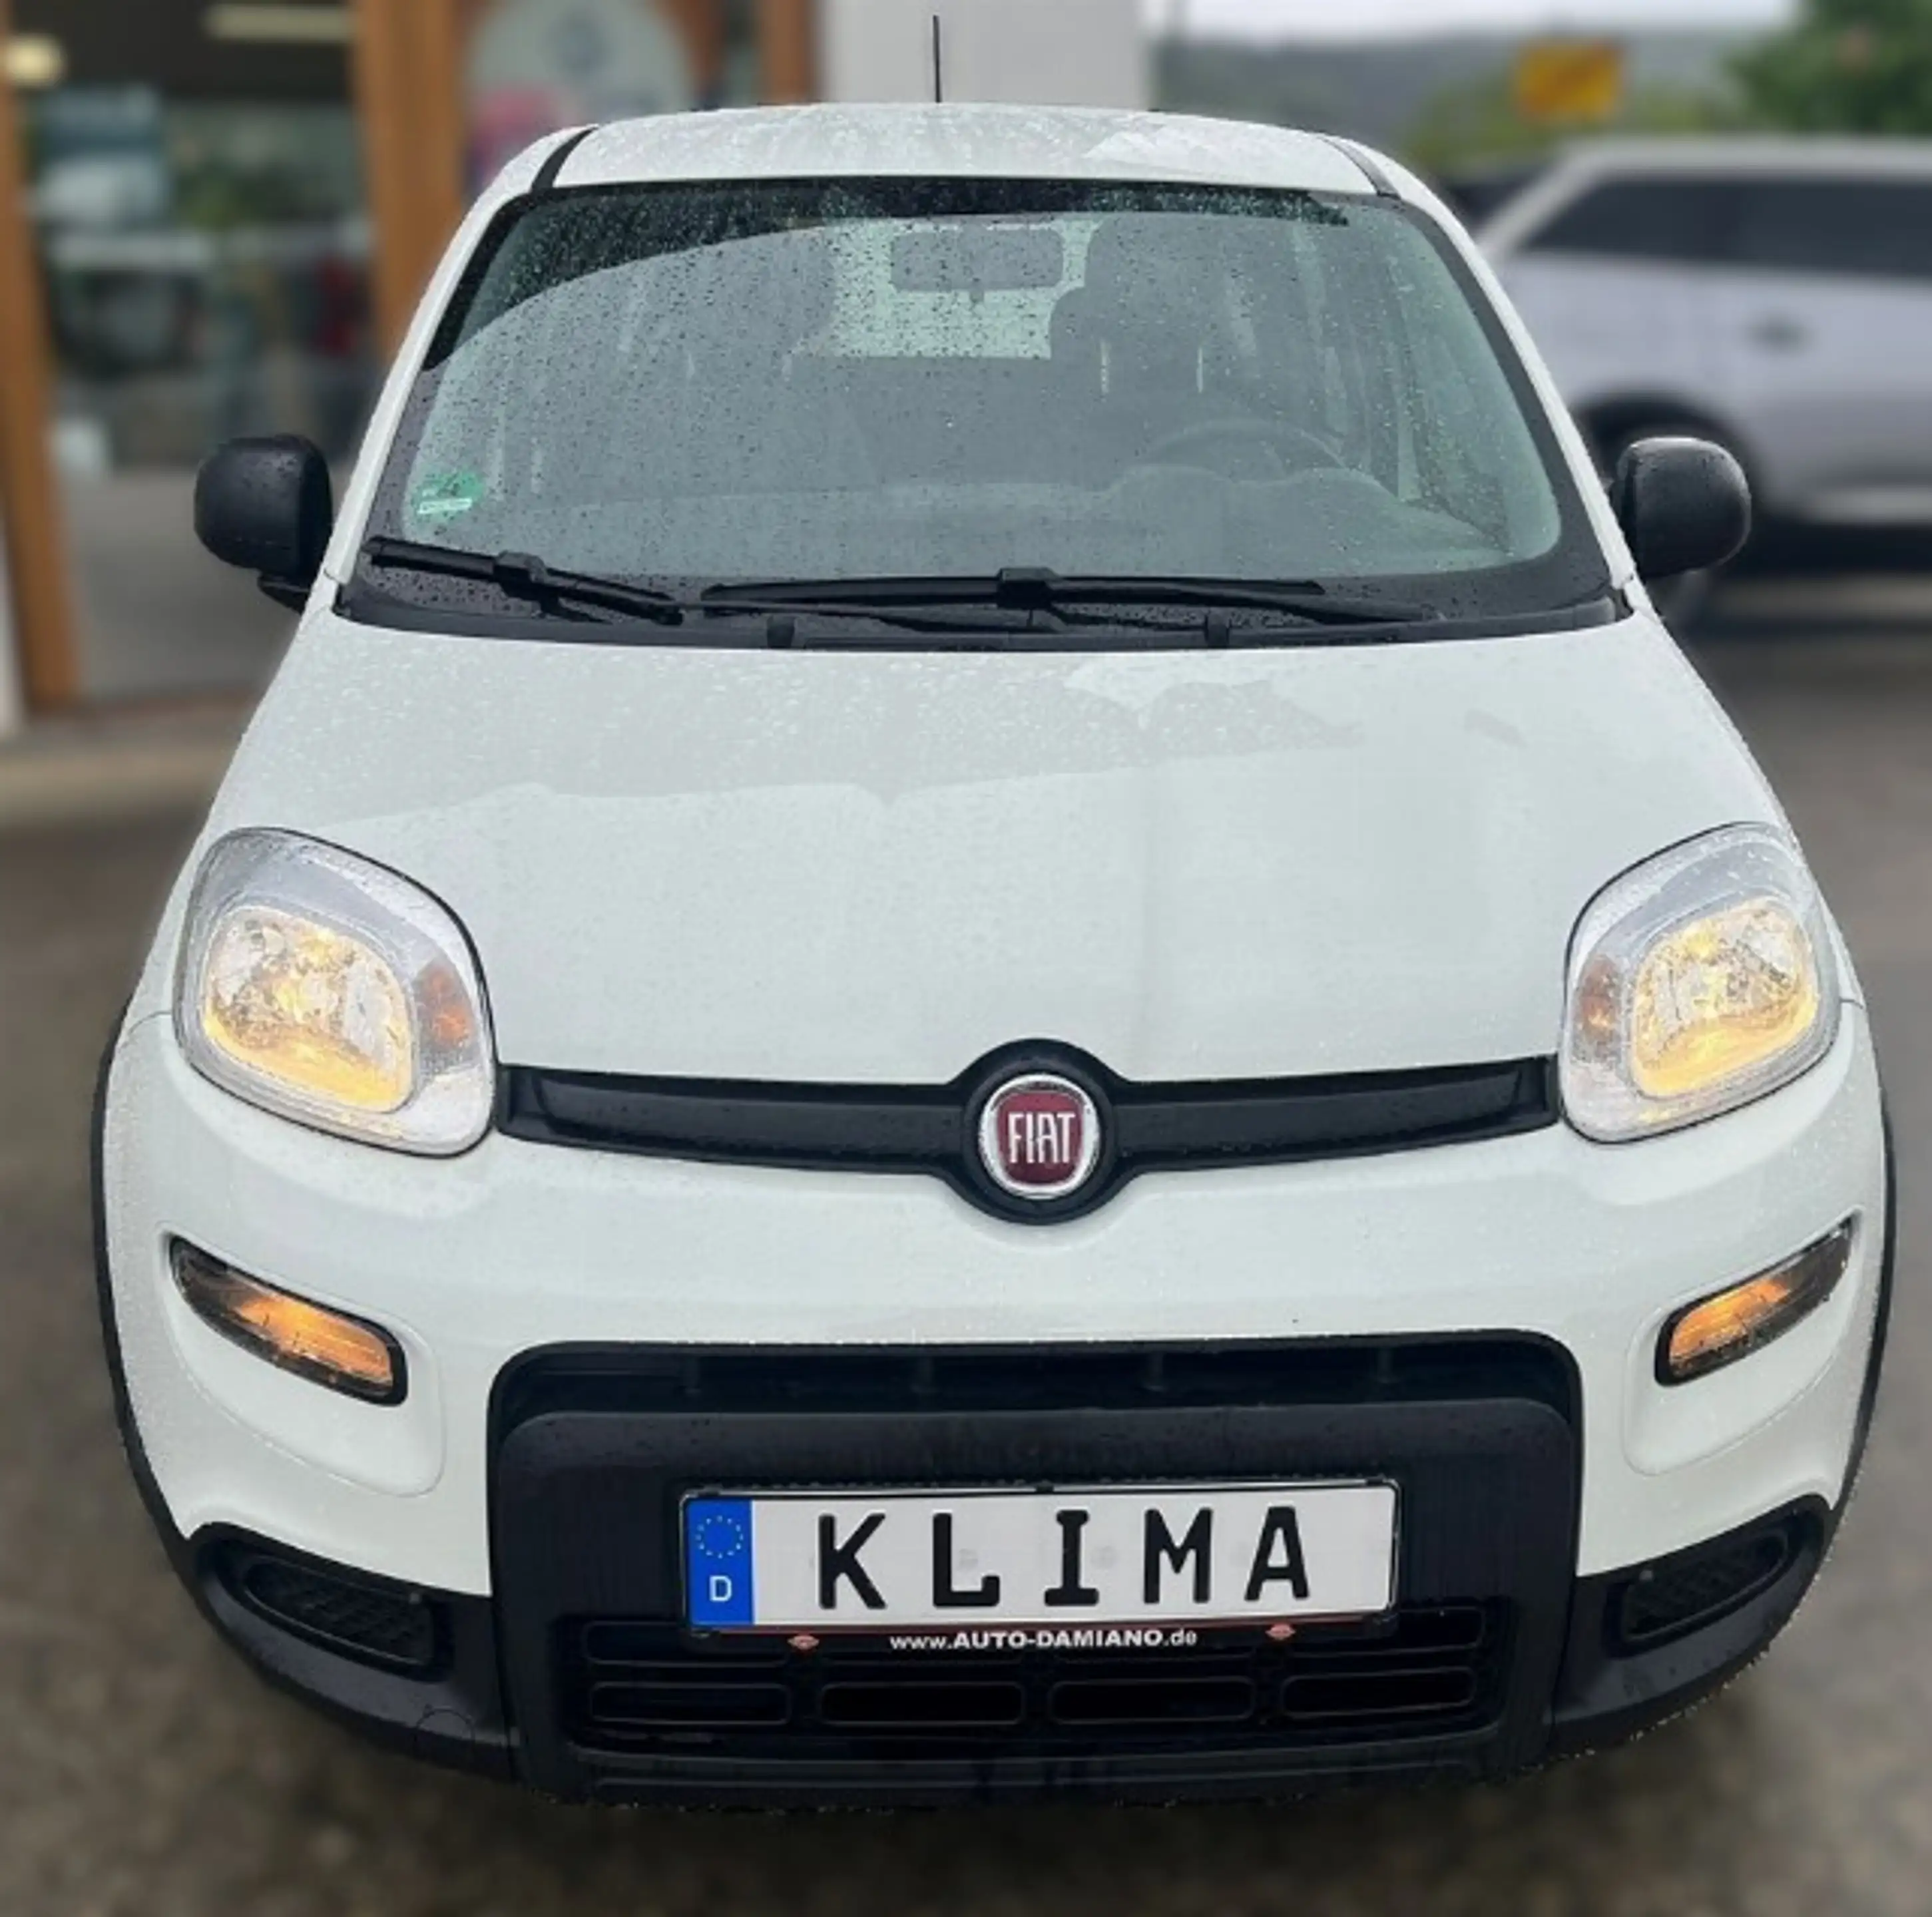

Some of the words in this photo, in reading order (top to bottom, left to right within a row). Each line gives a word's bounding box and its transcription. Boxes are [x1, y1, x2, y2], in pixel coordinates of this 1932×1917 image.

[1008, 1112, 1076, 1164] FIAT
[818, 1506, 1310, 1609] KLIMA
[709, 1575, 732, 1601] D
[889, 1628, 1197, 1649] www.AUTO-DAMIANO.de
